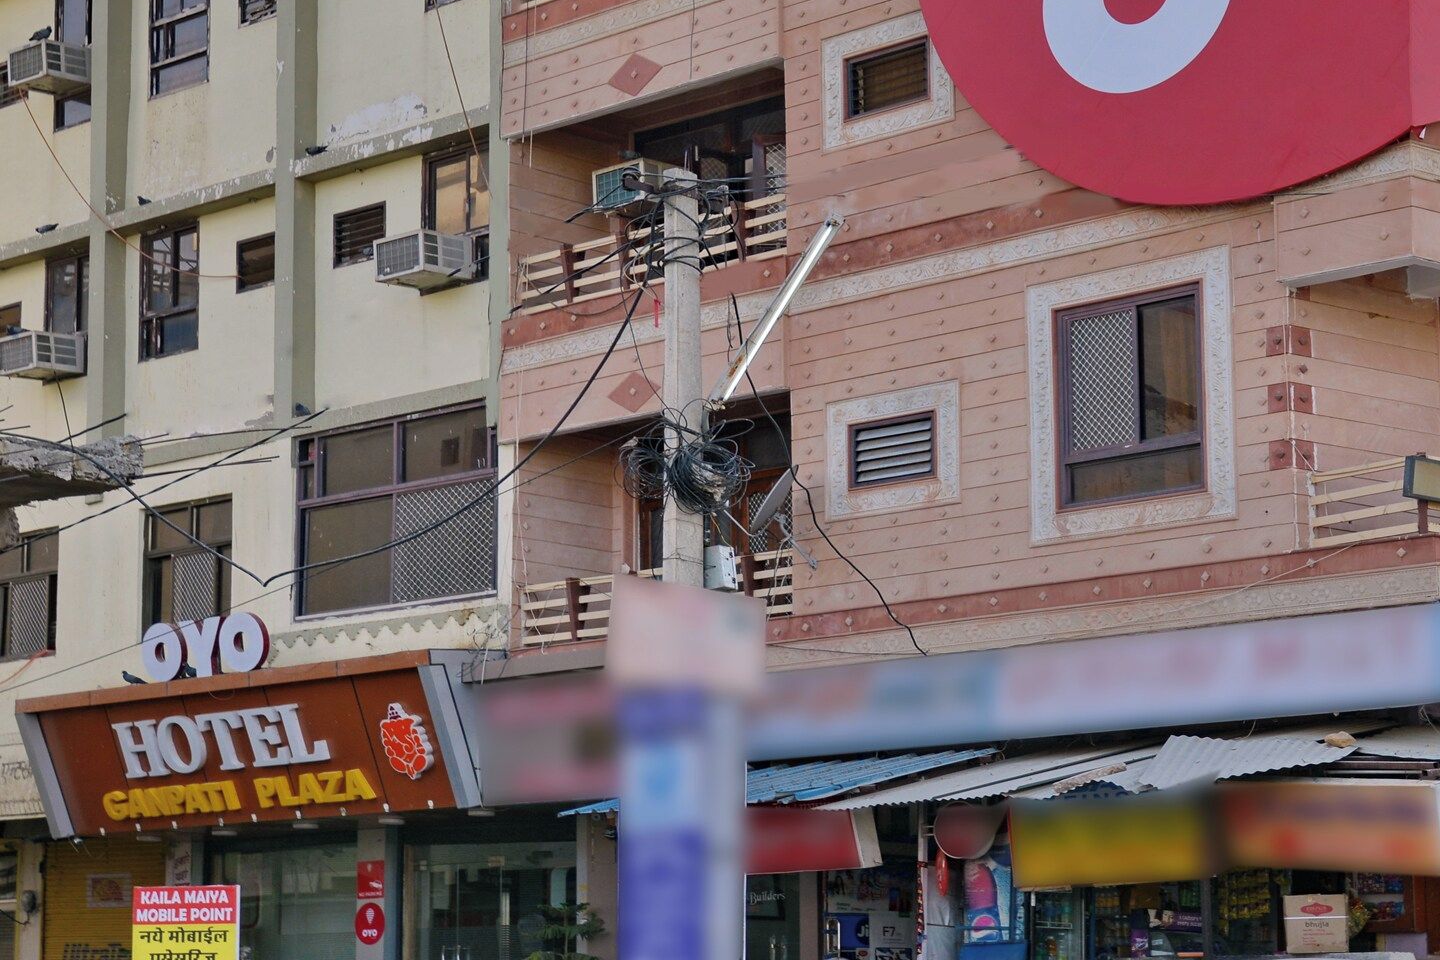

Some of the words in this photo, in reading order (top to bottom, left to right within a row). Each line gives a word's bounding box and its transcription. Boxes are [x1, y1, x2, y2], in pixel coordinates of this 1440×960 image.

[142, 612, 271, 683] OYO
[111, 703, 332, 780] HOTEL
[103, 780, 241, 821] GANPATI
[253, 768, 377, 809] PLAZA
[140, 890, 181, 905] KAILA
[184, 890, 230, 904] MAIYA
[749, 891, 787, 906] Builders
[136, 908, 188, 923] MOBILE
[190, 907, 233, 922] POINT
[139, 927, 165, 944] नये
[168, 926, 230, 944] मोबाईल
[362, 928, 378, 938] OYO
[882, 926, 896, 937] F7
